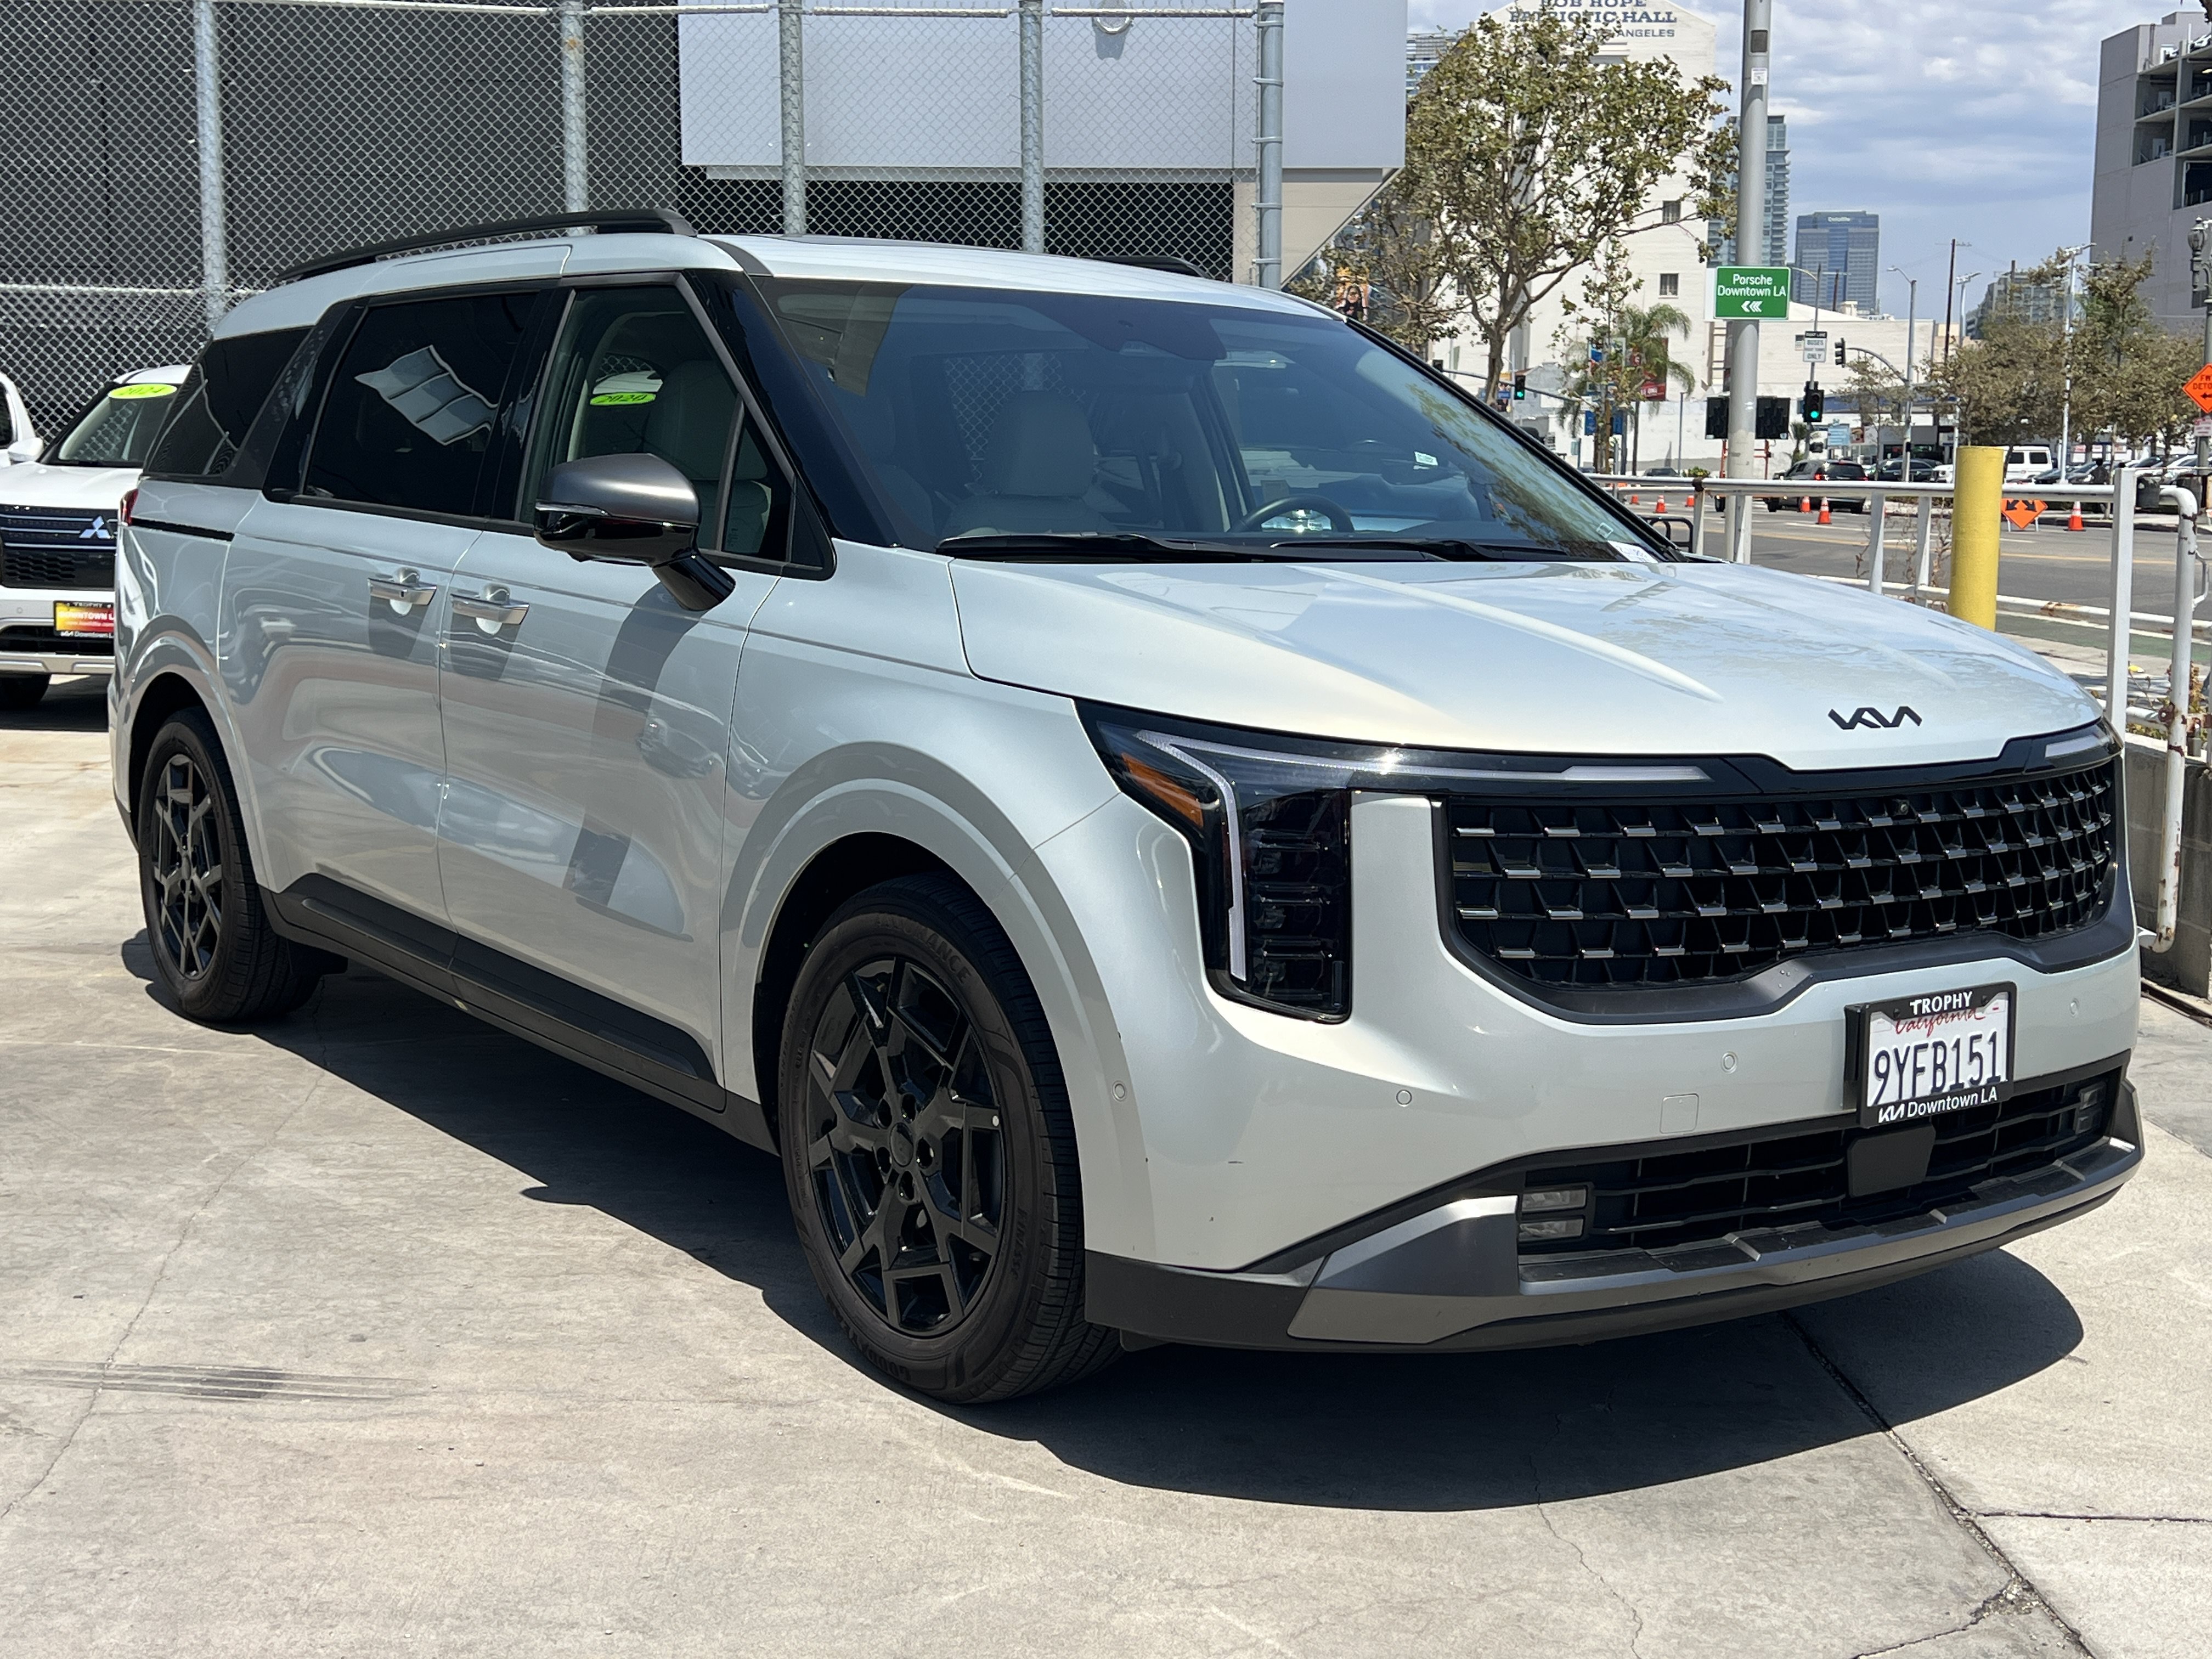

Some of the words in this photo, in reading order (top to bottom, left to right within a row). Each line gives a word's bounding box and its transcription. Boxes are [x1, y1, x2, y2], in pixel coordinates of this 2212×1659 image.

[1622, 12, 1677, 22] HALL
[1617, 29, 1675, 37] ANGELES
[1733, 274, 1773, 285] Porsche
[1717, 285, 1771, 297] Downtown
[1773, 285, 1787, 297] LA
[1909, 991, 1973, 1015] TROPHY
[1873, 1030, 2001, 1105] 9YFB151
[1907, 1092, 1978, 1117] Downtown
[1980, 1086, 1997, 1103] LA
